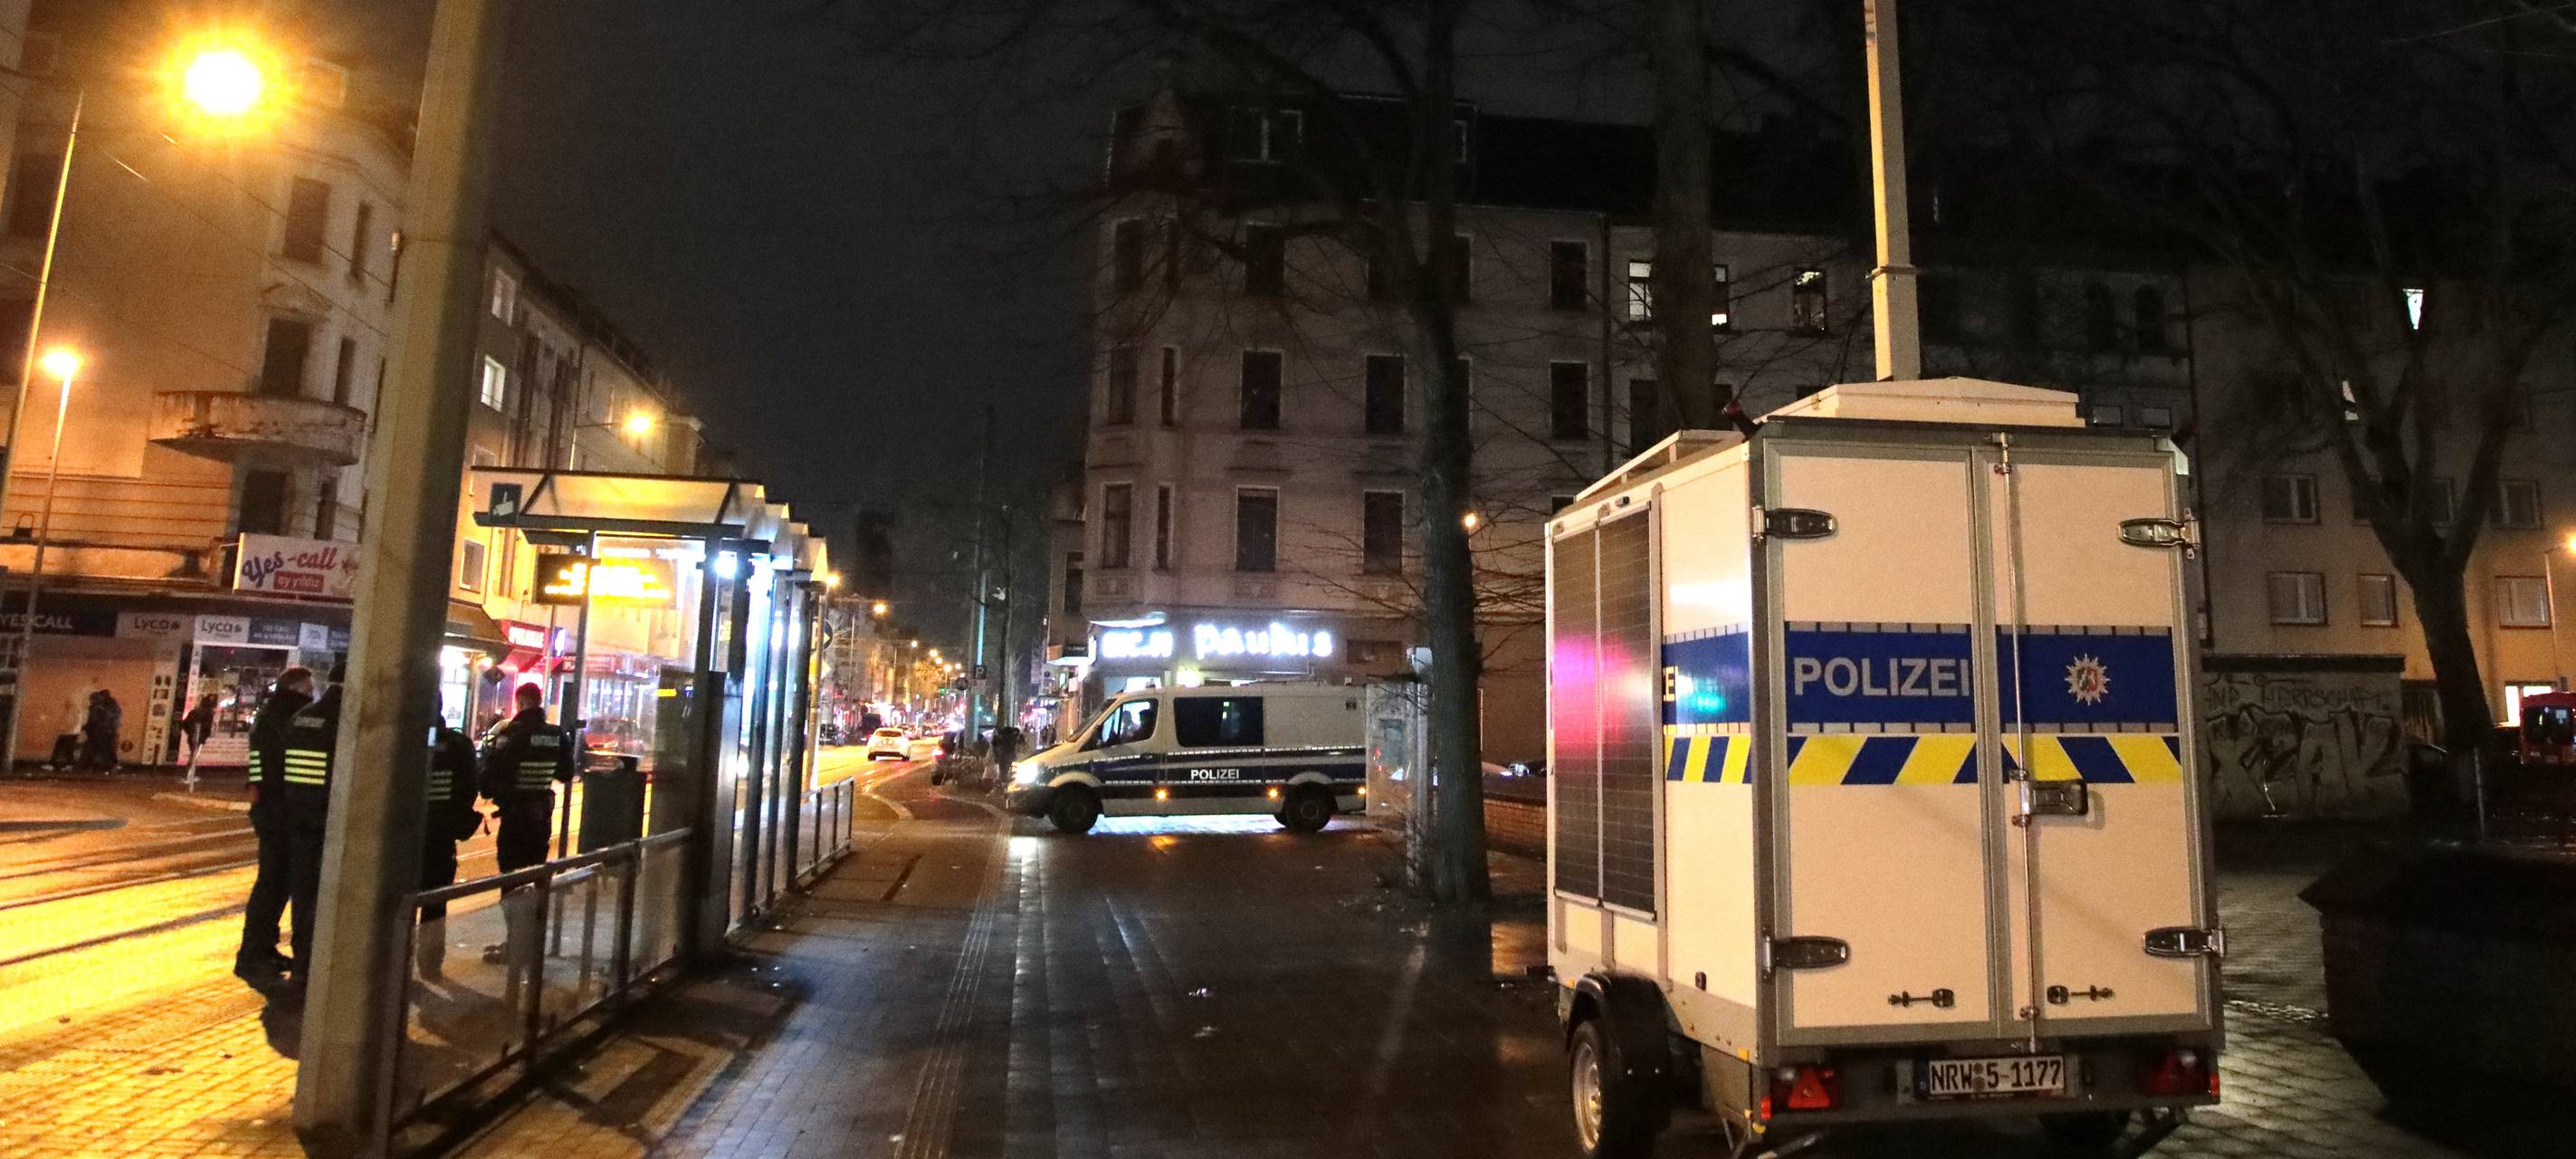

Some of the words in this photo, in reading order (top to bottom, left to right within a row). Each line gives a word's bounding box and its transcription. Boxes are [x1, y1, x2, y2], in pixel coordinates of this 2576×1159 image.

[33, 615, 73, 629] CALL
[1793, 656, 1970, 696] POLIZEI
[1190, 768, 1239, 780] POLIZEI
[1931, 1063, 1972, 1091] NRW
[1987, 1059, 2062, 1088] 5-1177
